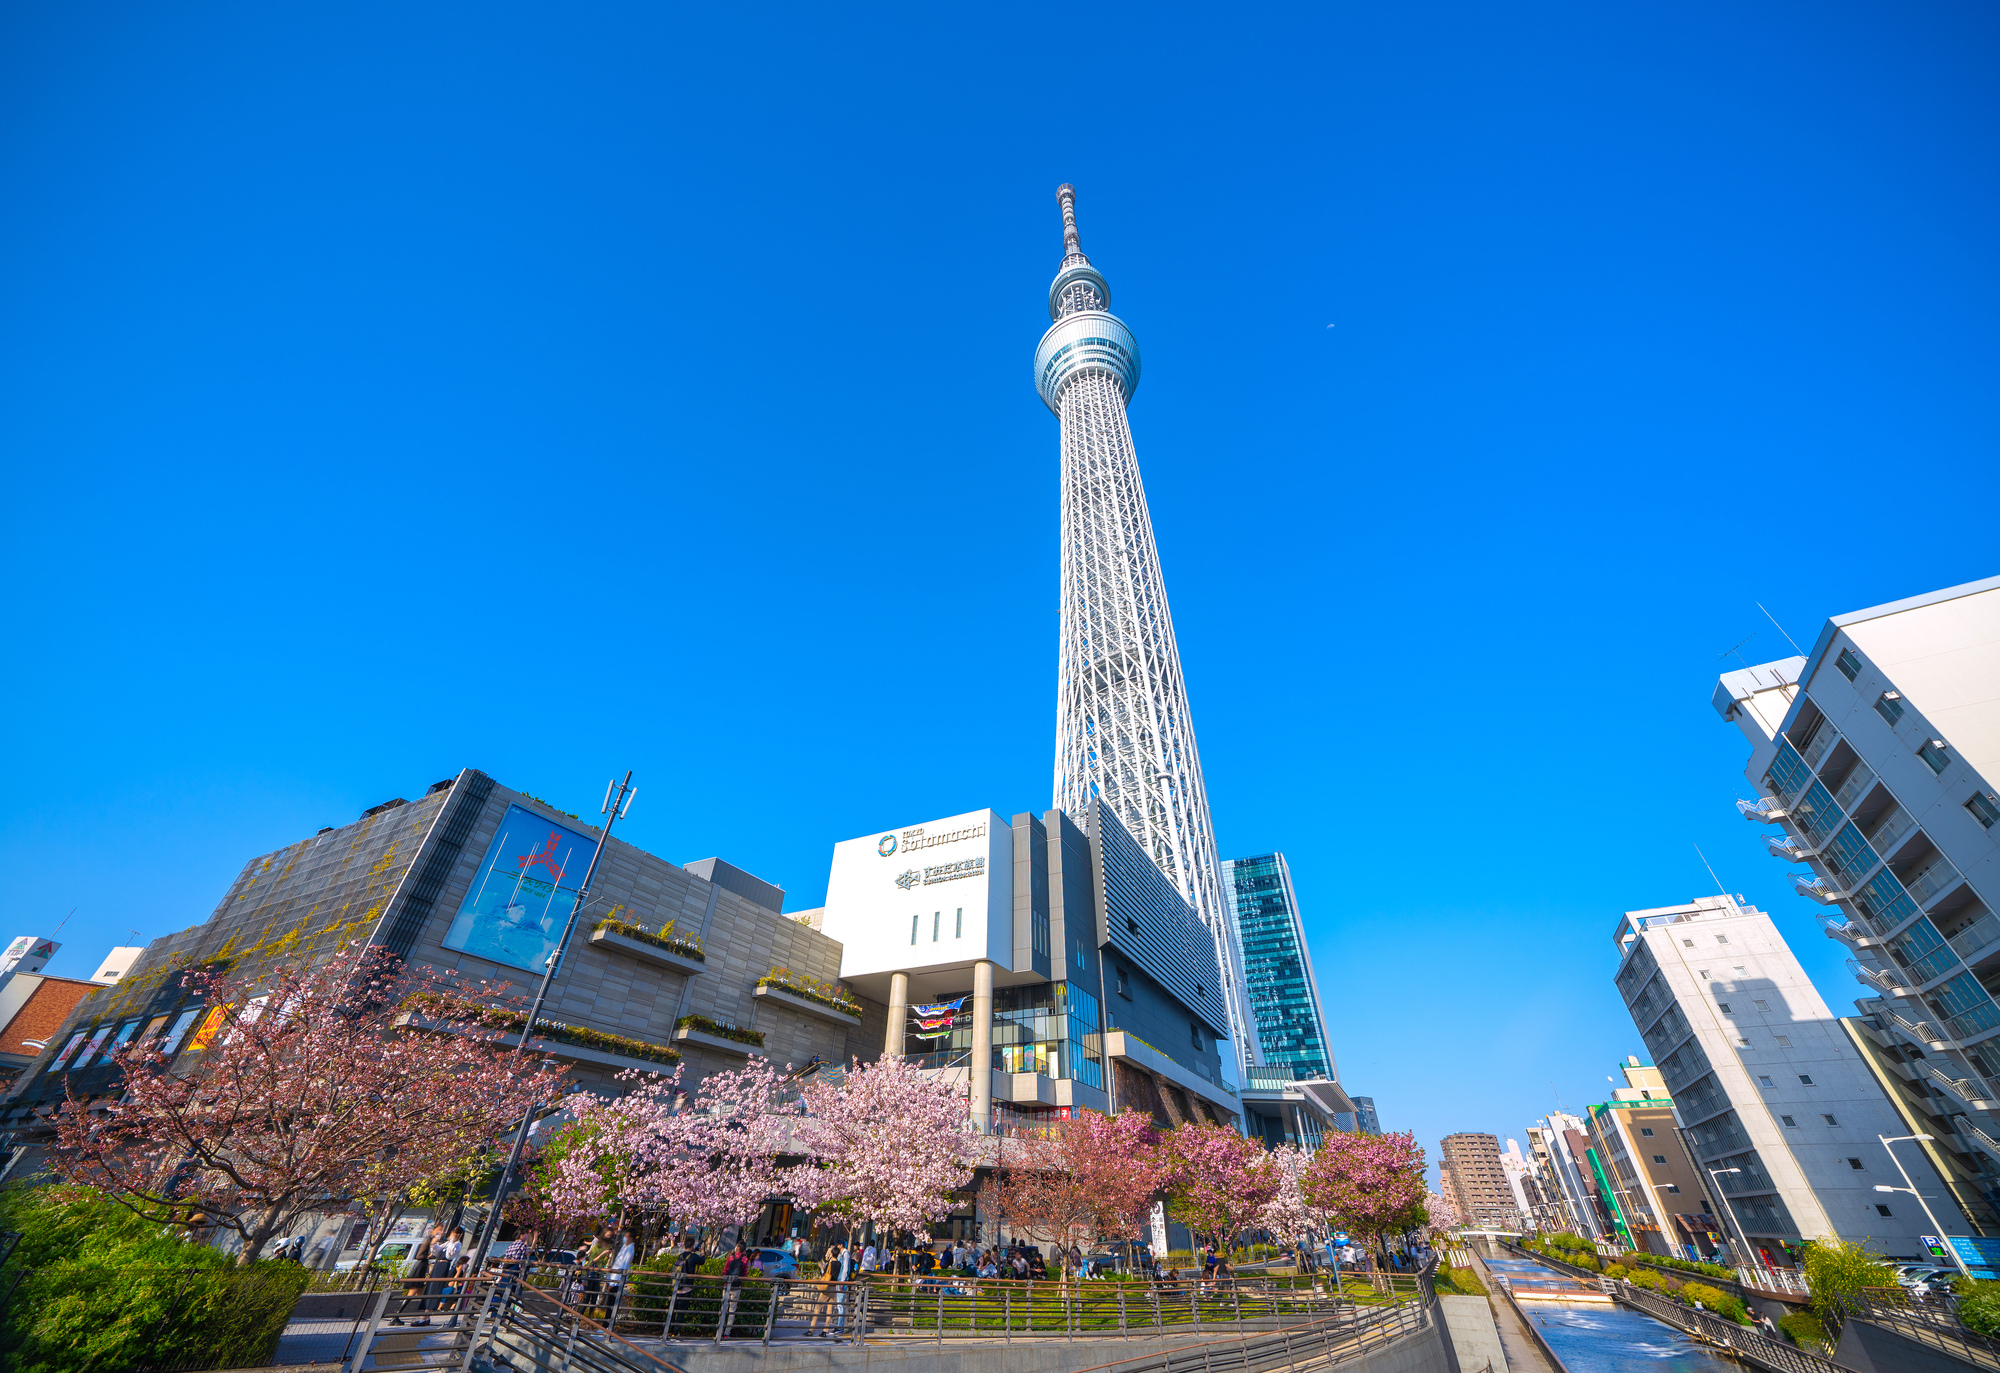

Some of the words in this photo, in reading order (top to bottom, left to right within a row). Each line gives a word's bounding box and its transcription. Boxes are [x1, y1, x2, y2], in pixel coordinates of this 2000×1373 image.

[901, 822, 986, 853] Solamachi
[923, 856, 985, 878] すみだ水族館
[1925, 1237, 1936, 1246] P
